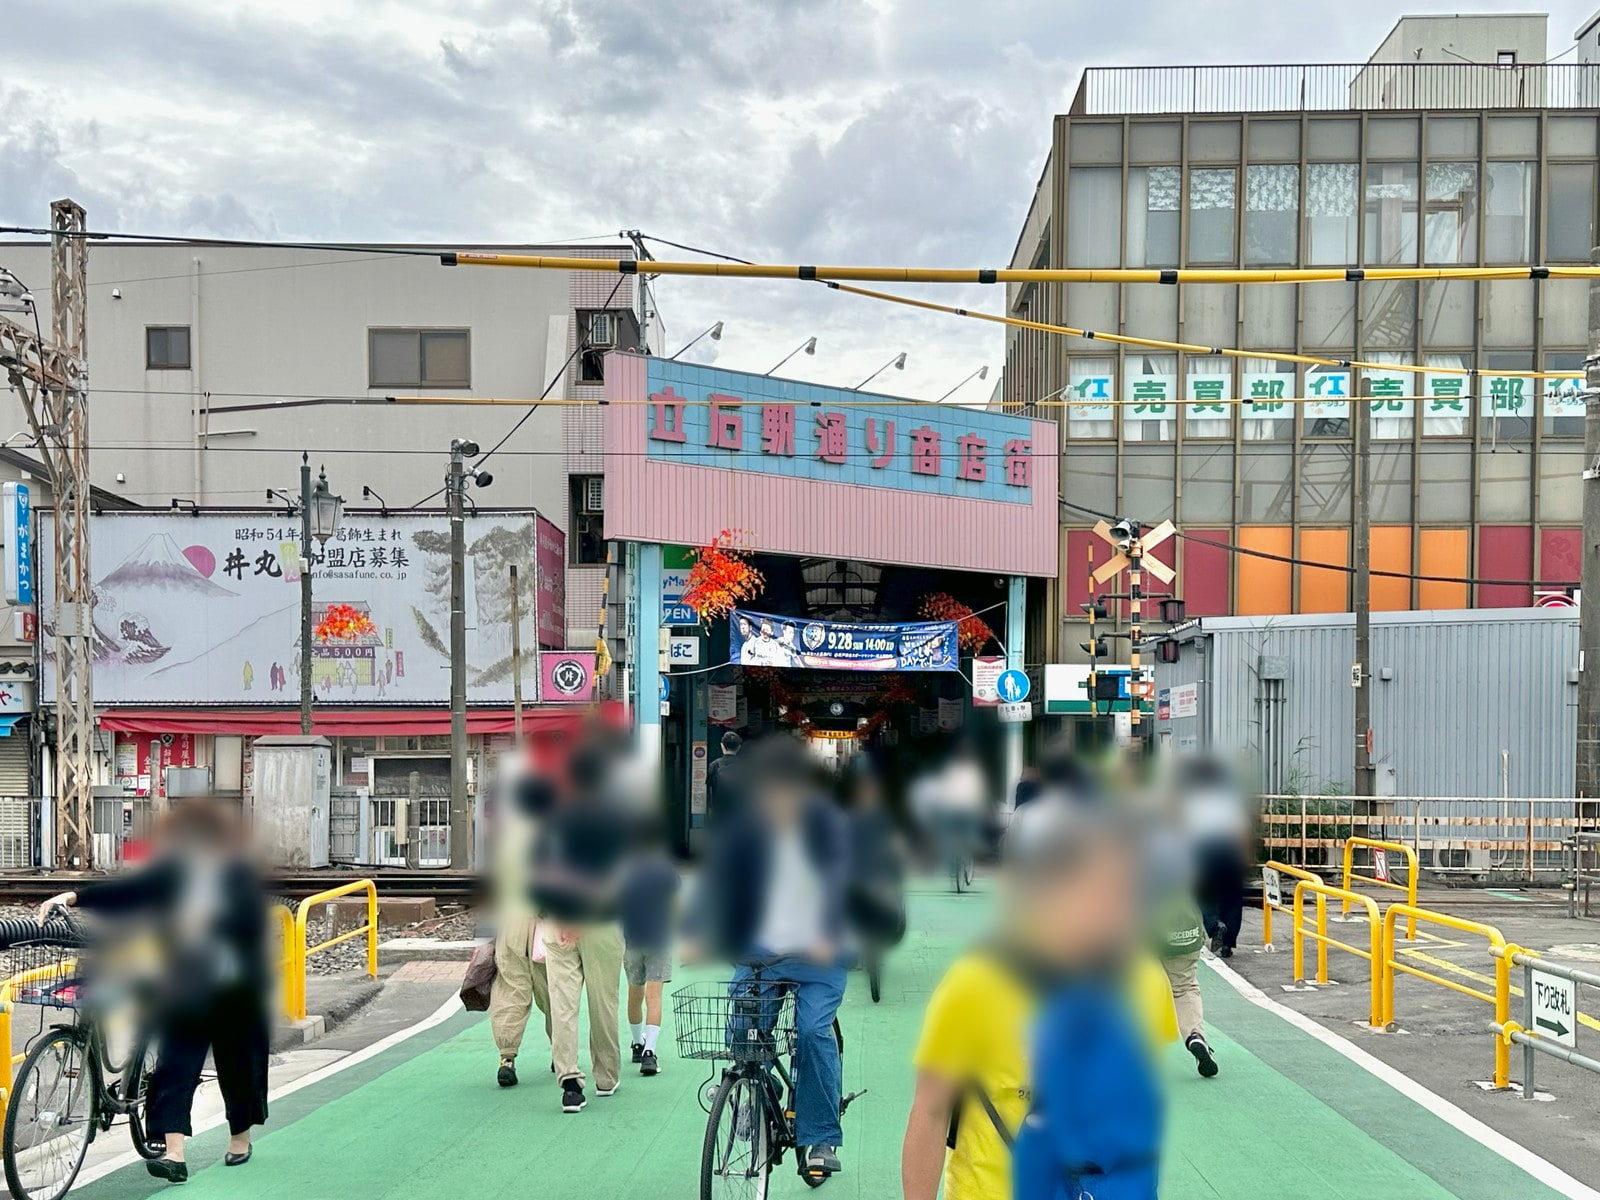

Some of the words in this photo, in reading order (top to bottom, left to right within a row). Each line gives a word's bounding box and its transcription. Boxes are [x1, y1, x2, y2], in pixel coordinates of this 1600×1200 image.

[649, 386, 1033, 488] 立石駅通り商店街
[235, 528, 303, 541] 昭和54年
[18, 523, 29, 590] がまかつ
[223, 547, 283, 581] 丼丸
[312, 570, 407, 580] nfo@sasafune.co.jp
[664, 608, 691, 619] PEN
[670, 643, 693, 658] ばこ
[828, 632, 853, 649] 9.28
[865, 638, 886, 651] 14:00
[1535, 981, 1571, 1016] 下り改札
